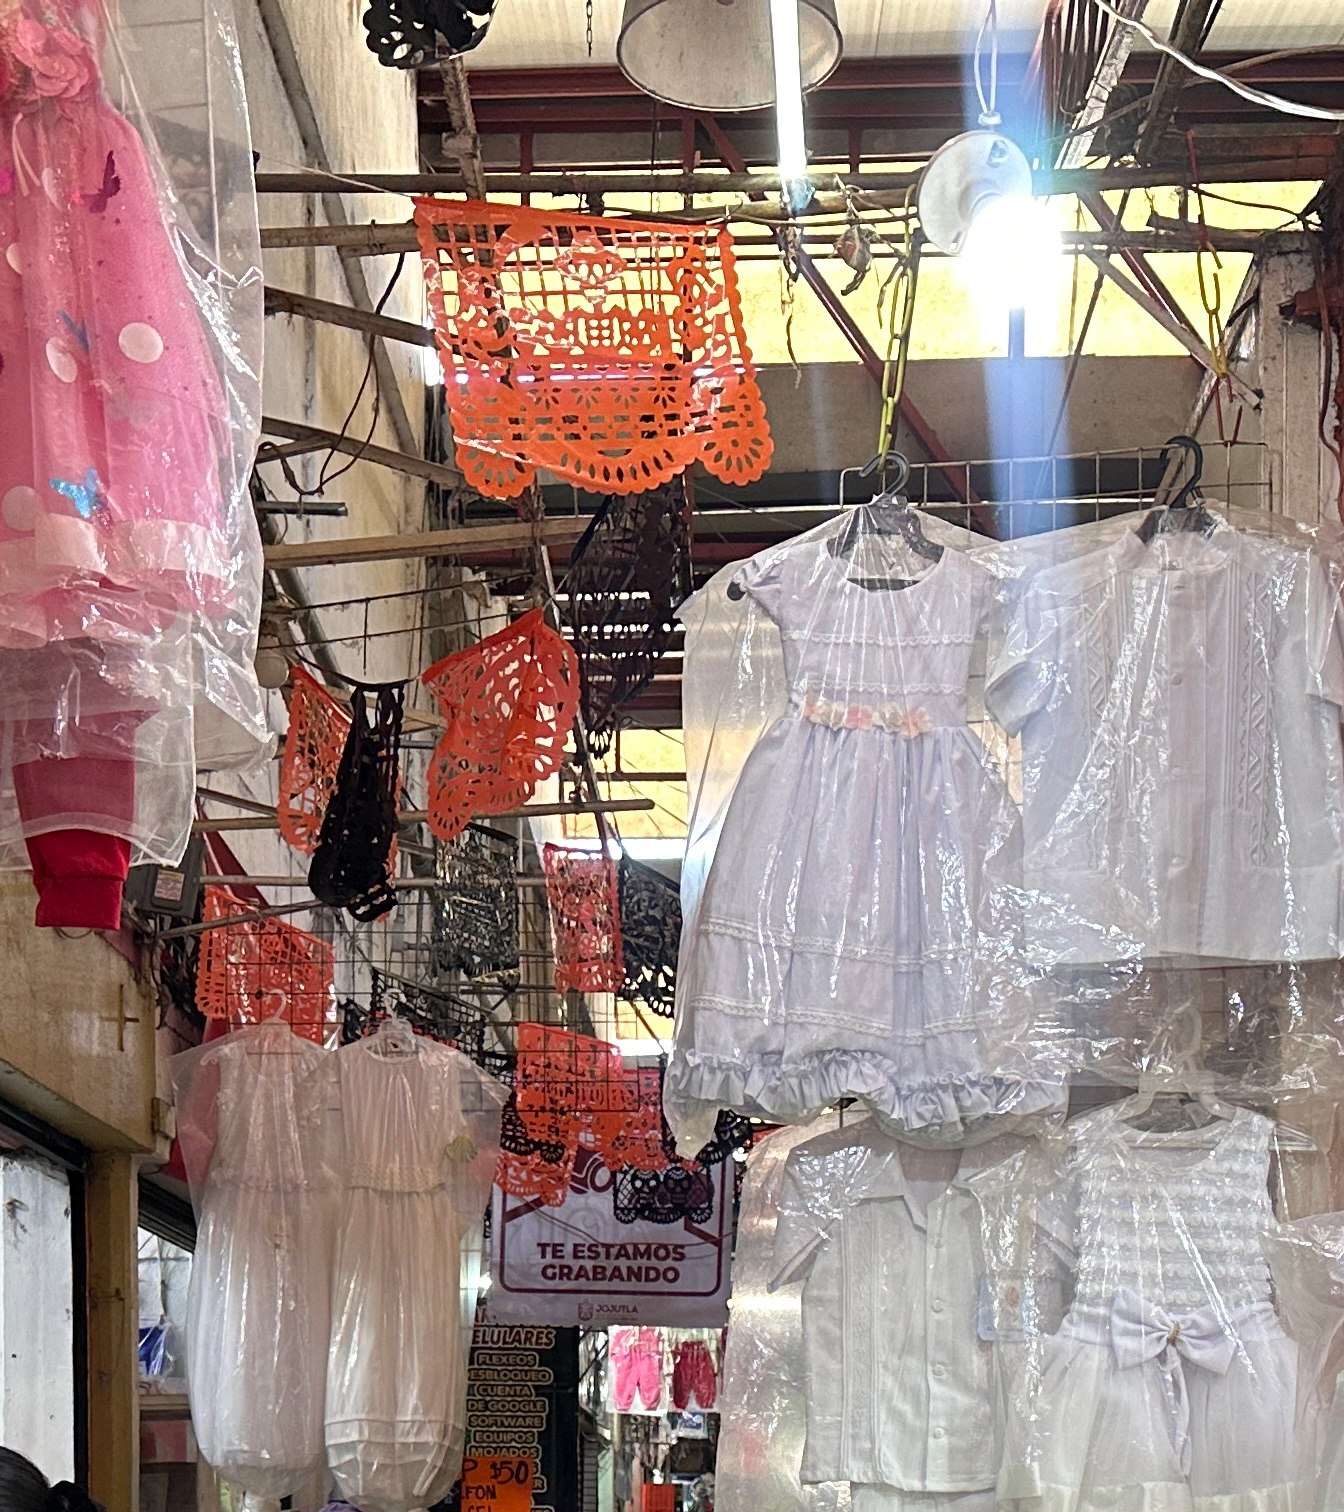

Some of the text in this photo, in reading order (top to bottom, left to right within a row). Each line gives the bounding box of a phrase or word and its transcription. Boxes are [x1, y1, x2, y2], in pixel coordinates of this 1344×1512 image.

[537, 1243, 686, 1262] TE ESTAMOS
[541, 1264, 680, 1284] GRABANDO
[472, 1328, 555, 1347] ELULARES
[478, 1354, 535, 1366] FLEXEOS
[469, 1370, 550, 1381] ESBLOQUEO
[478, 1385, 532, 1396] CUENTA
[467, 1401, 545, 1412] DE GOOGLE
[469, 1416, 542, 1427] SOFTWARE
[475, 1432, 534, 1443] EQUIPOS
[471, 1446, 538, 1458] MOJADOS
[490, 1460, 530, 1485] $50
[461, 1485, 497, 1501] FON
